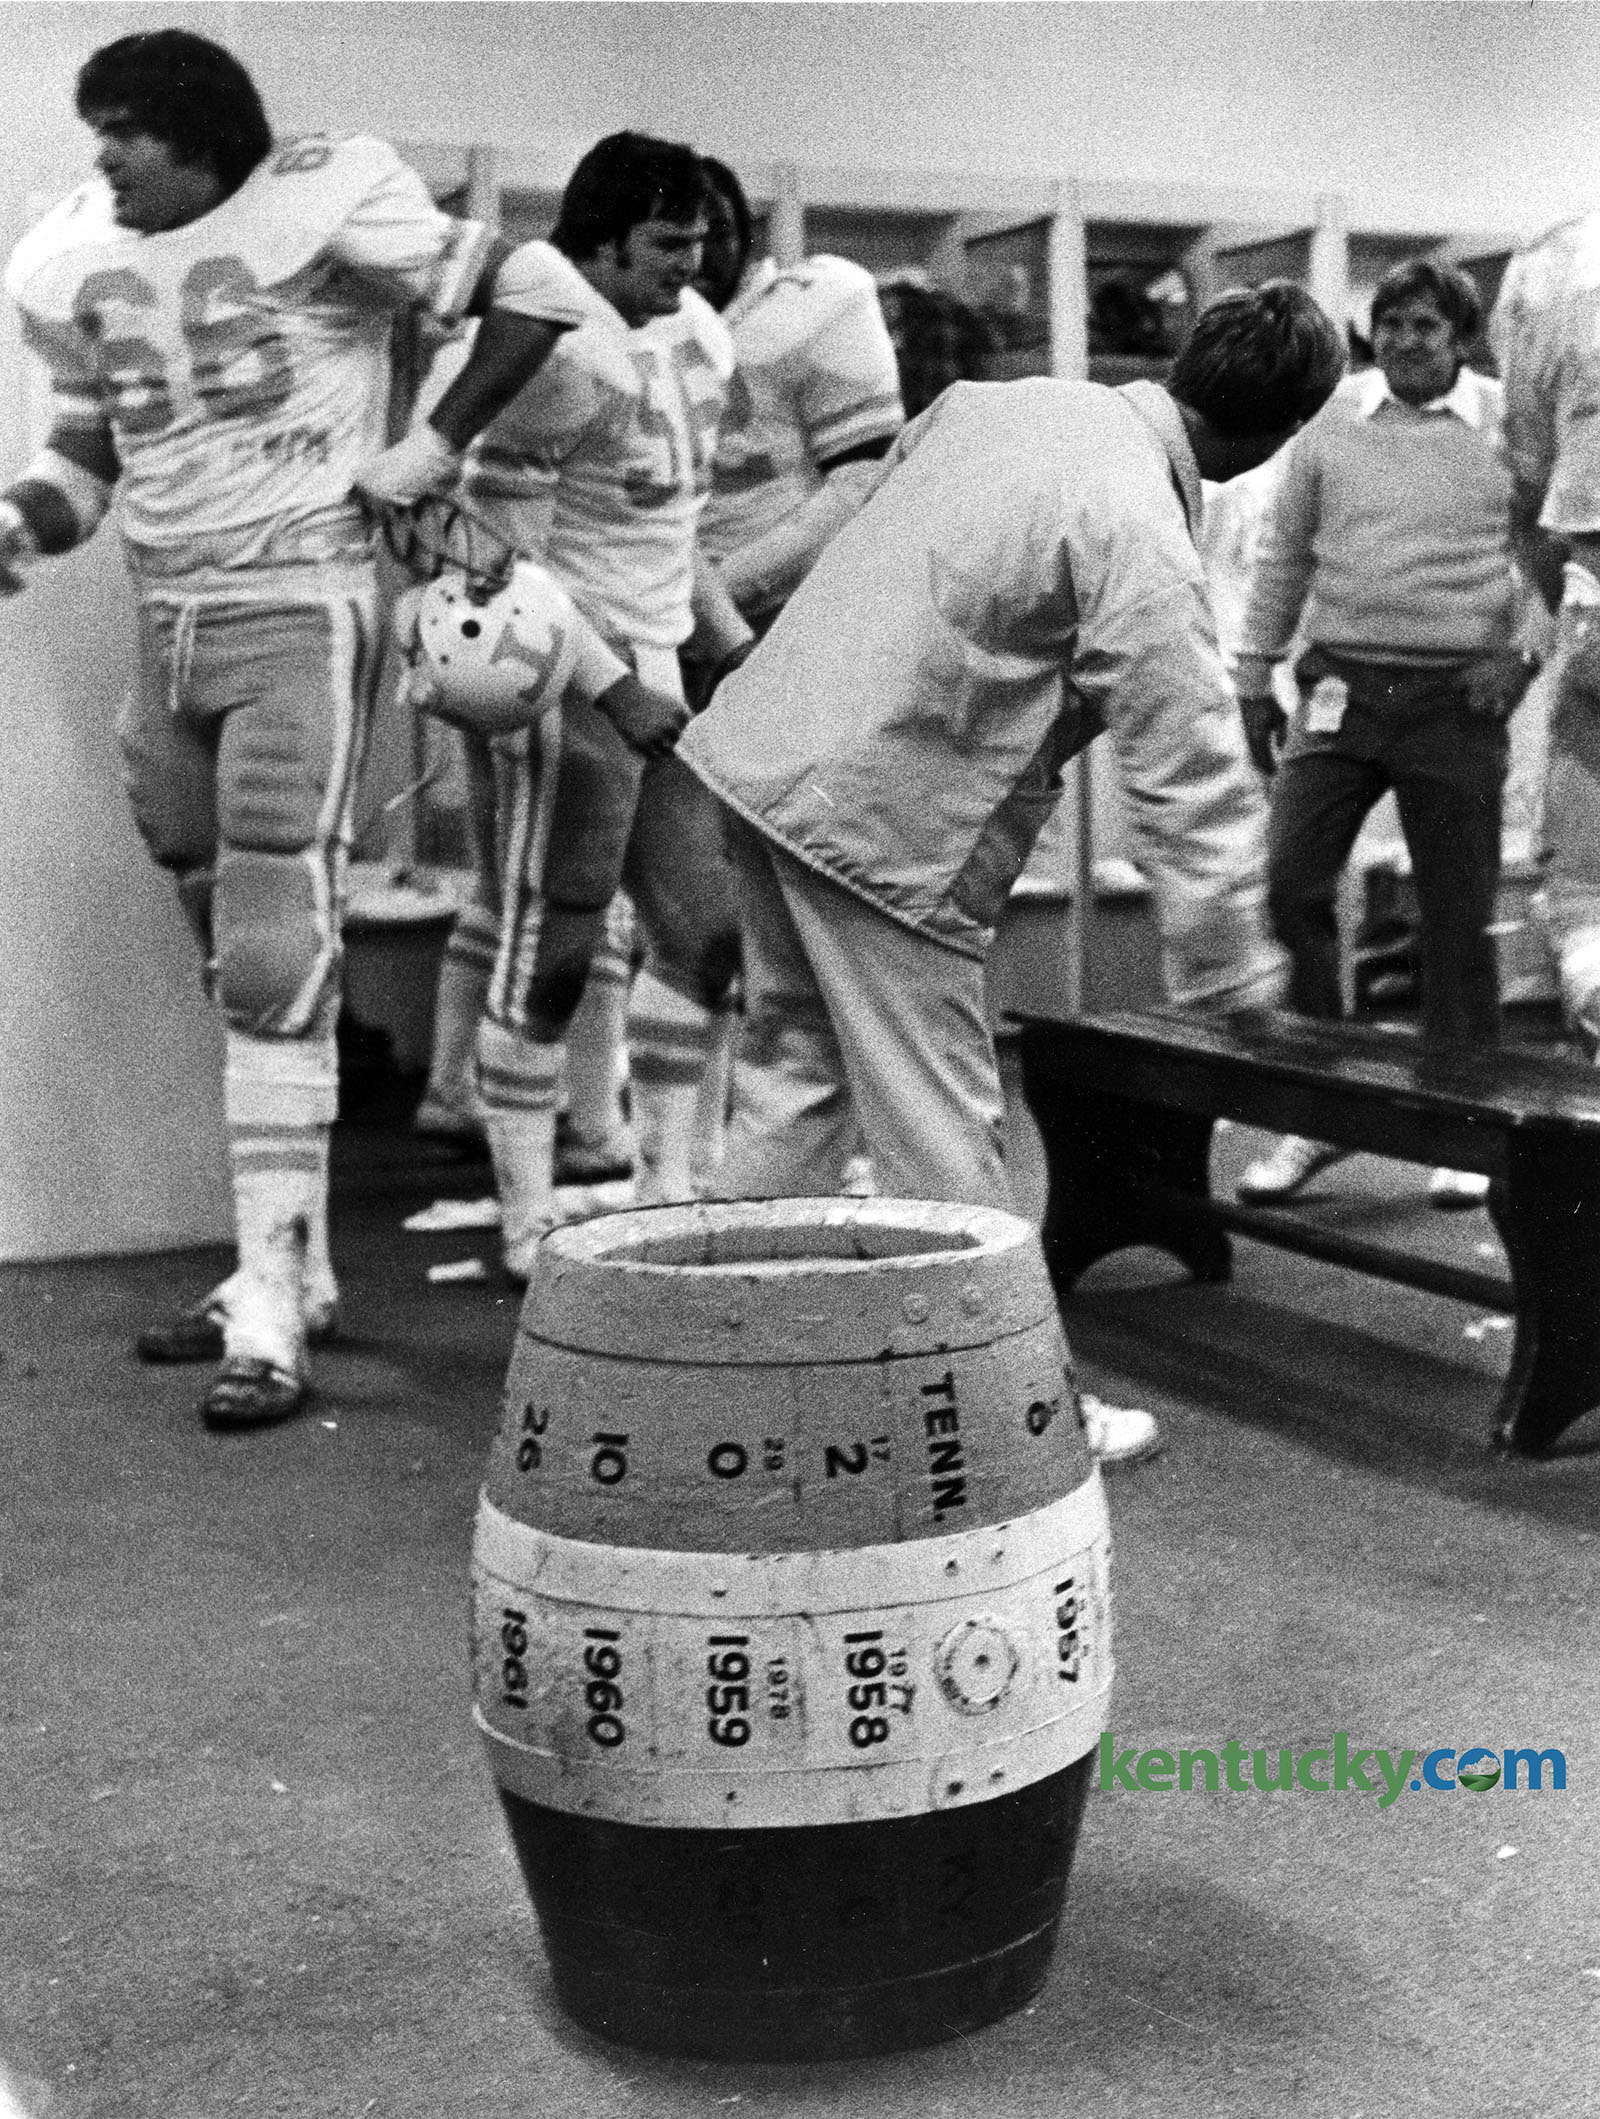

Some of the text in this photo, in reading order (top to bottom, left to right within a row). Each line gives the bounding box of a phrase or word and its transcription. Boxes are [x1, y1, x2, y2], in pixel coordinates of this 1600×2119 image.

[516, 1402, 549, 1472] 26
[591, 1432, 629, 1485] 10
[825, 1443, 868, 1478] 2
[921, 1372, 967, 1523] TENN.
[502, 1608, 529, 1710] 1961
[584, 1628, 625, 1747] 1960
[708, 1636, 751, 1747] 1959
[768, 1656, 791, 1719] 1978
[843, 1630, 890, 1749] 1958
